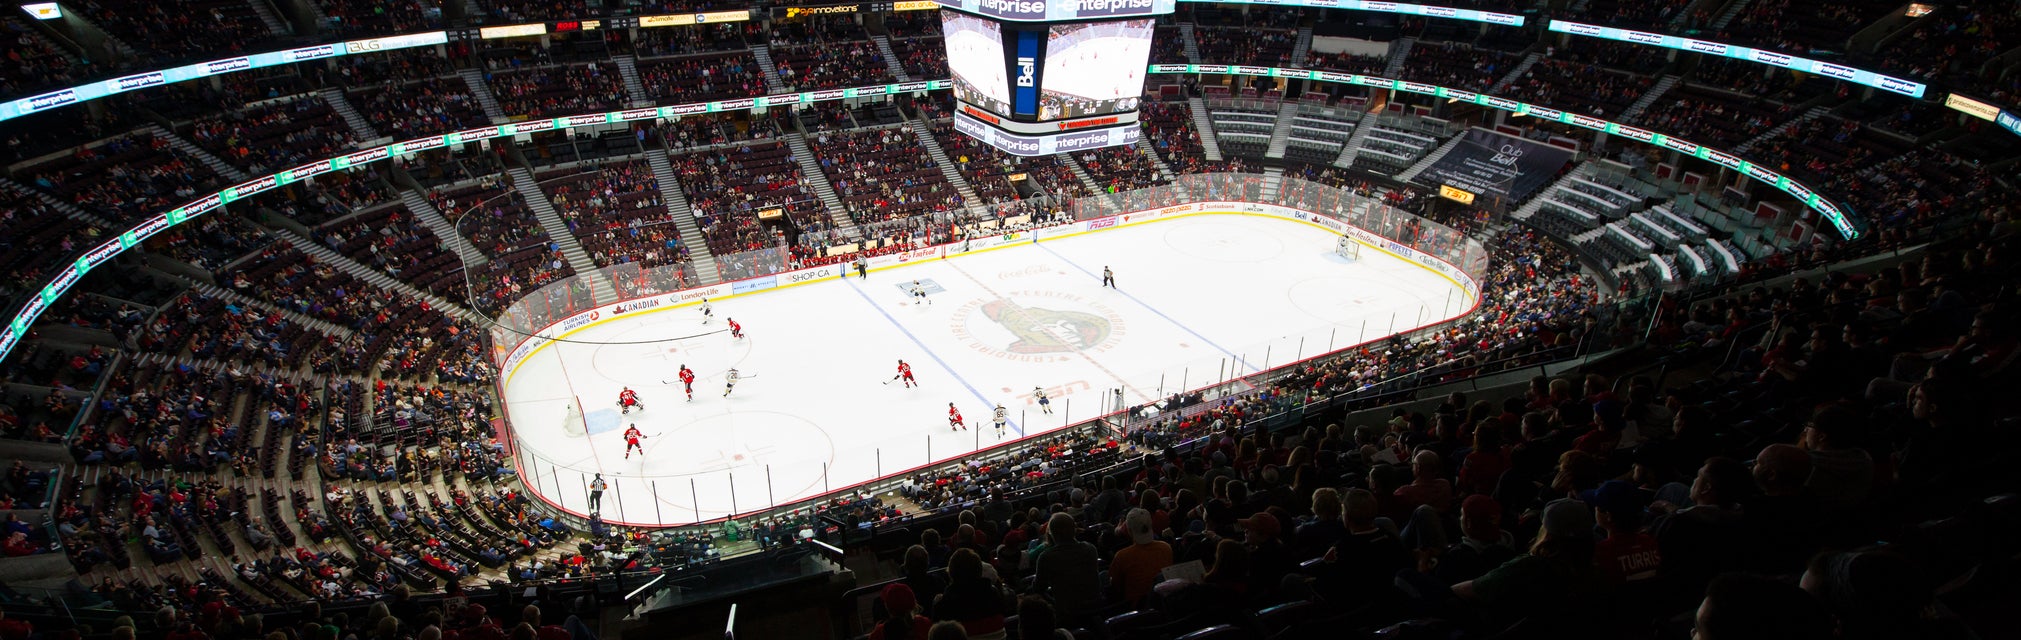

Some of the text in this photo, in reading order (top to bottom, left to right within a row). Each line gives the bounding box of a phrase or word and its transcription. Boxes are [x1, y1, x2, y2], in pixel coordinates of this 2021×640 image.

[557, 22, 578, 31] ROSS
[1017, 57, 1034, 87] Bell
[850, 86, 886, 96] enterprise
[892, 83, 926, 92] enterprise
[760, 95, 799, 106] enterprise
[805, 91, 843, 100] enterprise
[663, 105, 706, 115] enterprise
[713, 100, 754, 110] enterprise
[560, 115, 606, 127] enterprise
[612, 110, 657, 120] enterprise
[505, 121, 553, 133] enterprise
[451, 129, 498, 142] enterprise
[1047, 134, 1107, 148] enterprise
[395, 138, 443, 153] enterprise
[1500, 144, 1523, 158] Club
[338, 149, 387, 166] enterprise
[1490, 153, 1518, 168] Bell
[283, 162, 329, 180] enterprise
[227, 178, 275, 198] enterprise
[174, 196, 220, 220] enterprise
[1295, 211, 1308, 220] Bell
[125, 218, 167, 242] enterprise
[80, 241, 121, 268] enterprise
[681, 288, 719, 300] London Life
[624, 299, 660, 313] CANADIAN
[563, 313, 589, 326] TURKISH
[564, 319, 590, 332] AIRLINES
[996, 410, 1004, 418] 65
[1618, 550, 1661, 571] TURRIS
